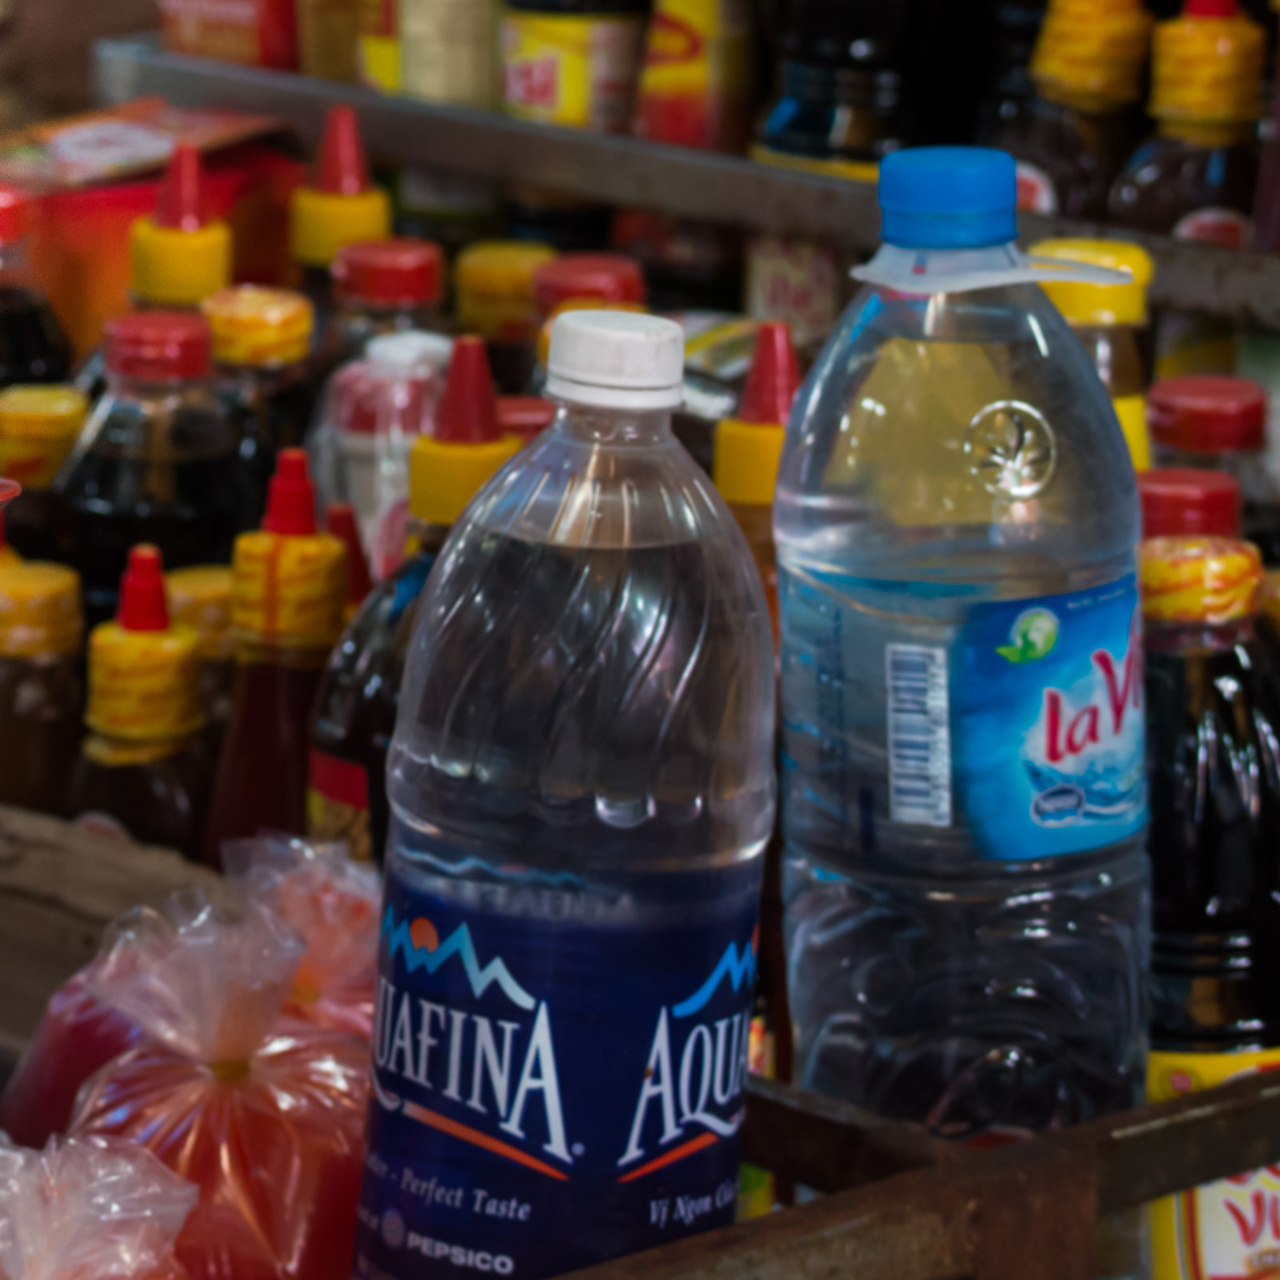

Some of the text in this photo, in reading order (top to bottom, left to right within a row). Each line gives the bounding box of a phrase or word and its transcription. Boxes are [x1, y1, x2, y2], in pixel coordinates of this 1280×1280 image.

[1043, 608, 1142, 764] laV
[371, 976, 574, 1166] UAFINA
[399, 1167, 464, 1208] Perfect
[473, 1189, 531, 1221] Taste
[407, 1232, 515, 1275] PEPSICO
